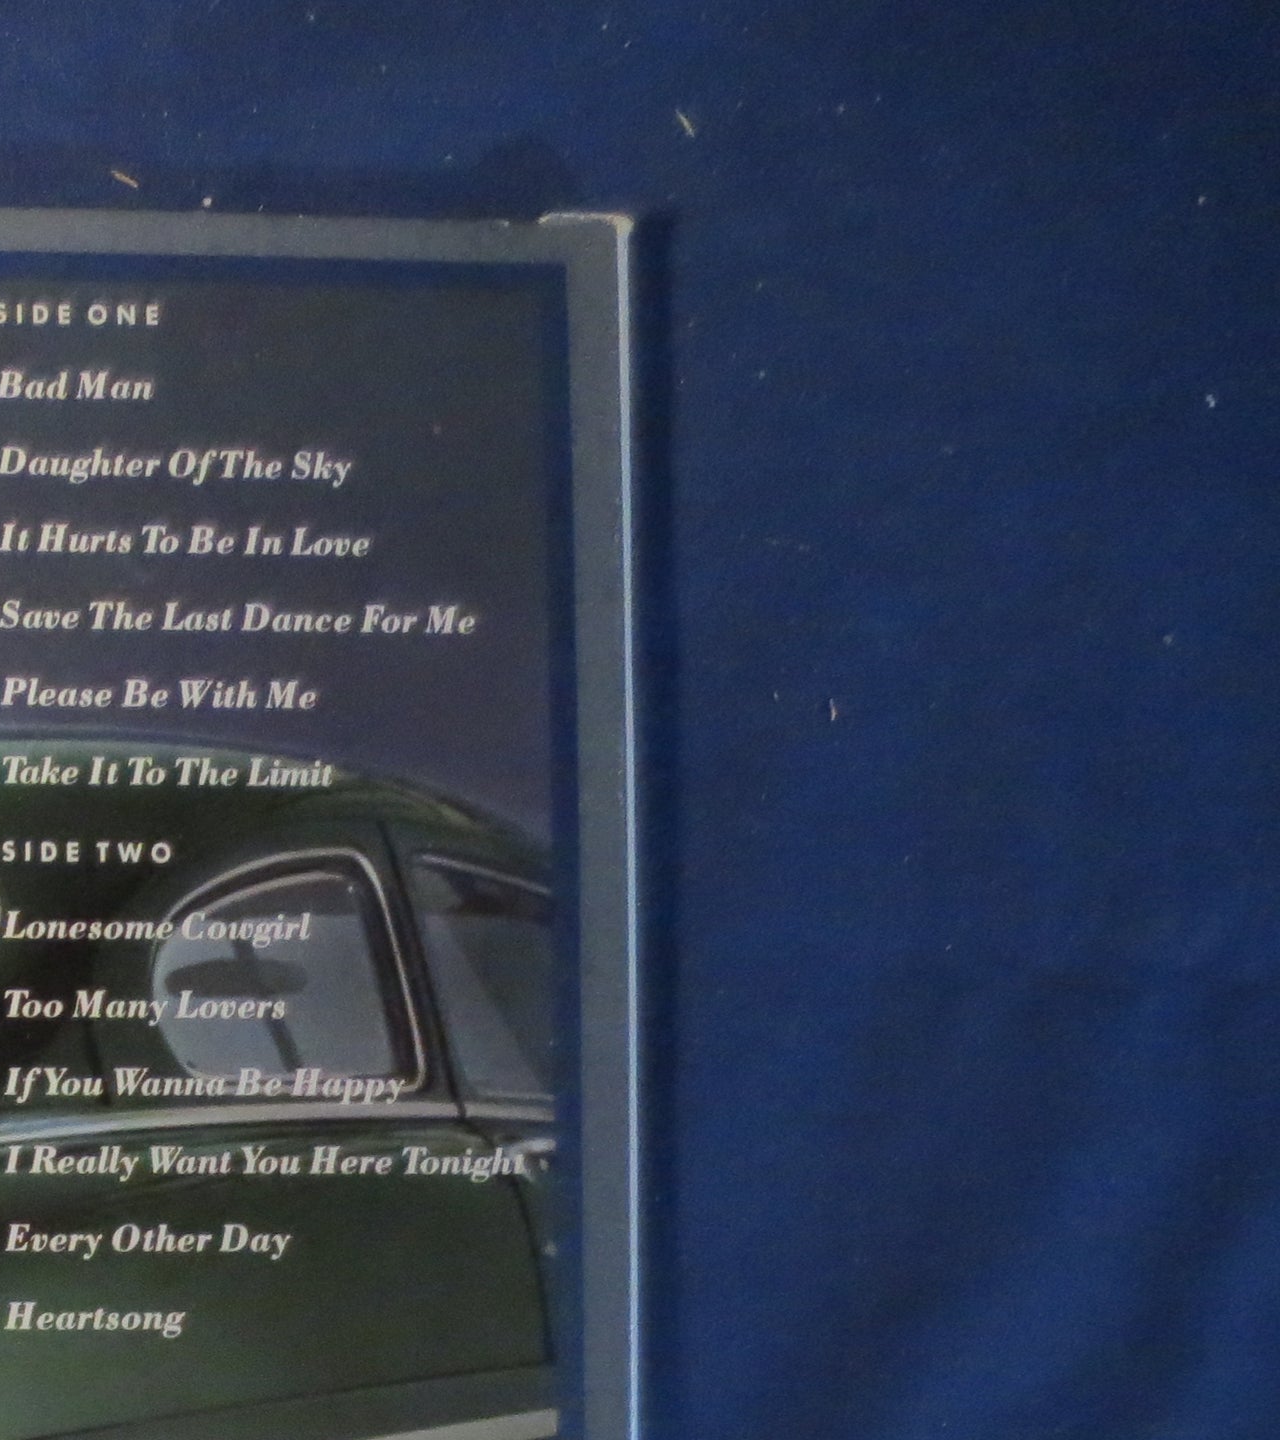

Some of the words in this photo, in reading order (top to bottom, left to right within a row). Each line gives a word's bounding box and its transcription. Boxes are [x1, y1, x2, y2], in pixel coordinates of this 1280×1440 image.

[87, 304, 160, 326] ONE
[76, 372, 153, 401] Man
[168, 450, 218, 484] Of
[218, 450, 281, 480] The
[291, 451, 351, 487] Sky
[38, 524, 132, 554] Hurts
[142, 525, 179, 555] To
[188, 526, 234, 555] Be
[244, 526, 283, 556] In
[290, 527, 370, 557] Love
[0, 600, 79, 631] Save
[89, 602, 152, 631] The
[161, 603, 232, 632] Last
[242, 604, 351, 633] Dance
[361, 605, 416, 634] For
[425, 606, 476, 635] Me
[0, 678, 112, 708] Please
[122, 679, 168, 708] Be
[178, 679, 256, 709] With
[266, 680, 316, 710] Me
[2, 756, 79, 786] Take
[88, 757, 118, 785] It
[128, 756, 165, 787] To
[176, 758, 238, 787] The
[247, 758, 333, 788] Limit
[1, 841, 80, 864] SIDE
[95, 841, 172, 864] TWO
[2, 911, 173, 941] Lonesome
[181, 911, 311, 950] Cowgirl
[4, 990, 63, 1019] Too
[73, 990, 167, 1025] Many
[175, 990, 286, 1020] Lovers
[4, 1068, 44, 1103] If
[44, 1068, 104, 1098] You
[113, 1068, 224, 1097] Wanna
[235, 1068, 281, 1097] Be
[290, 1068, 406, 1104] Happy
[5, 1146, 23, 1175] I
[31, 1146, 139, 1181] Really
[149, 1146, 231, 1175] Want
[241, 1146, 301, 1175] You
[310, 1145, 393, 1175] Here
[402, 1145, 525, 1181] Tonight
[6, 1224, 103, 1259] Every
[112, 1224, 211, 1253] Other
[219, 1224, 291, 1259] Day
[4, 1301, 185, 1338] Heartsong
